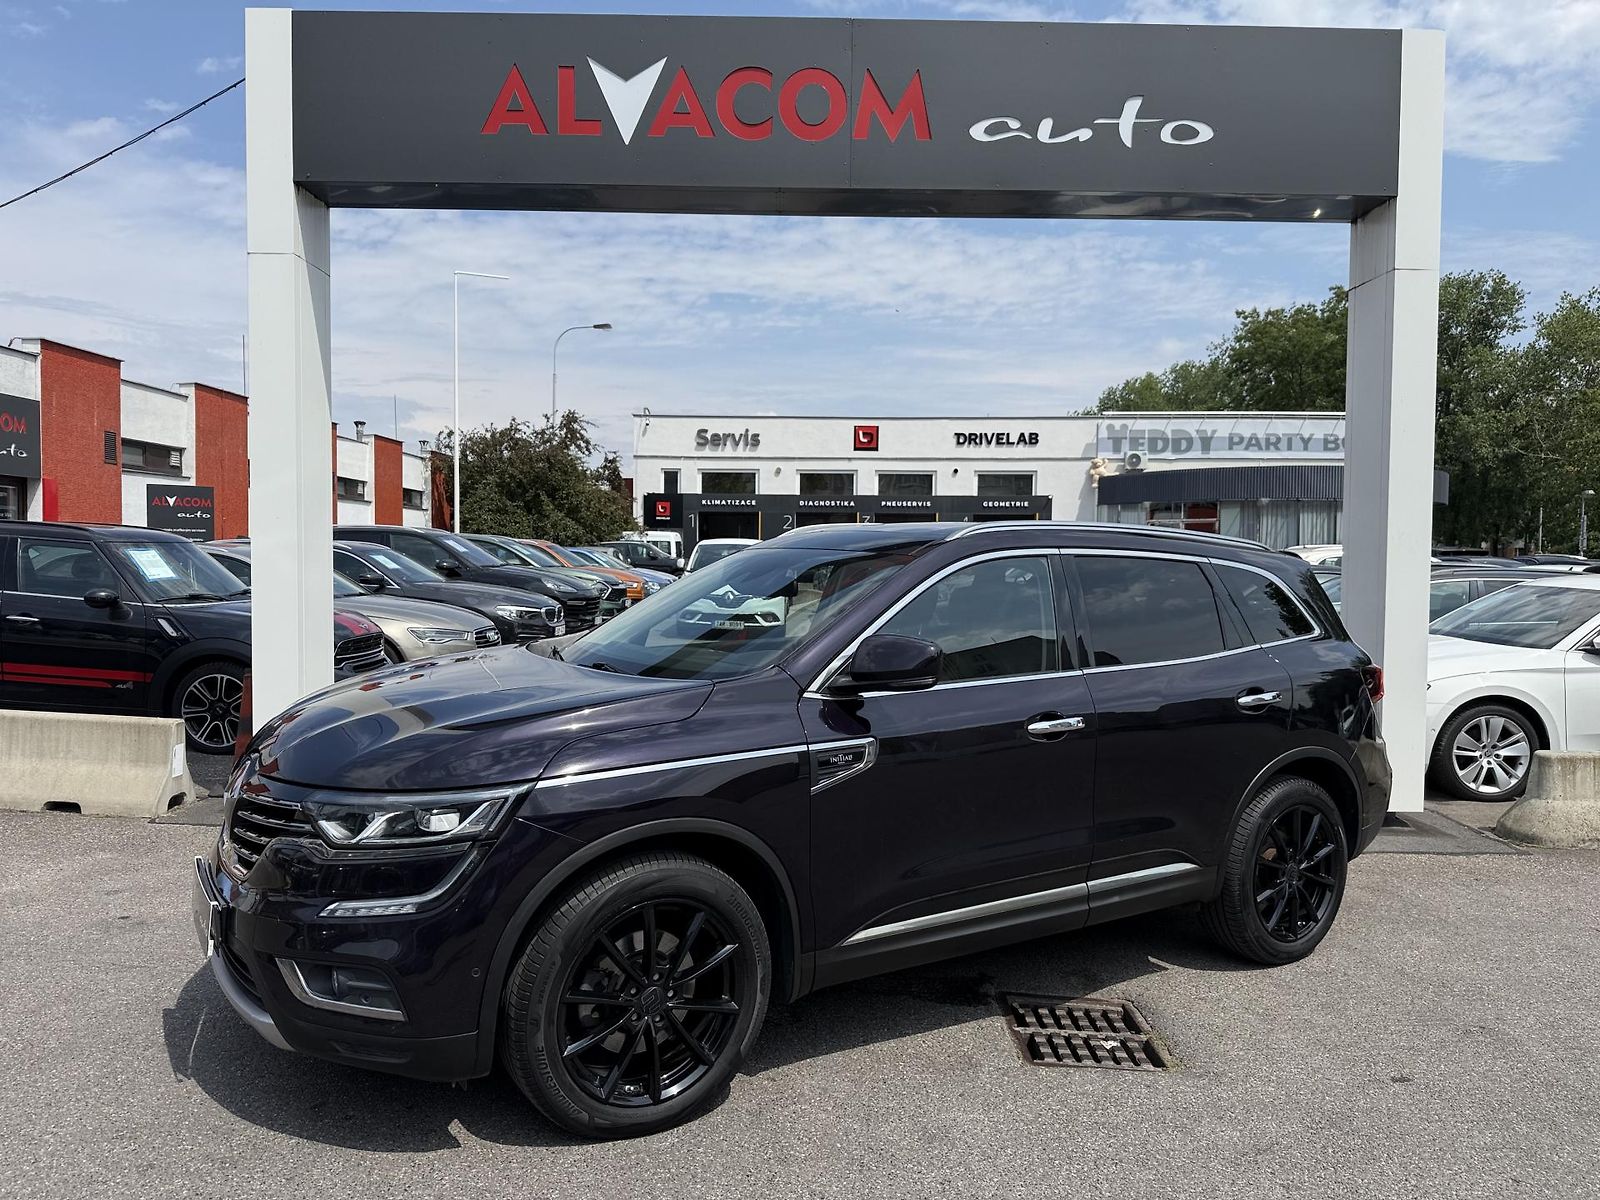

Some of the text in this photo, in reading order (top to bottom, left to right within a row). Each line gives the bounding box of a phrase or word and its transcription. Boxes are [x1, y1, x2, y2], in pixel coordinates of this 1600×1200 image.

[479, 55, 1215, 149] ALVACOM auto
[696, 428, 761, 448] Servis
[954, 432, 1040, 447] DRIVELAB
[1106, 423, 1218, 455] TEDDY
[1228, 433, 1314, 452] PARTY
[152, 495, 212, 507] ALVACOM
[881, 500, 931, 508] PNEUSERVIS
[177, 510, 211, 519] auto
[688, 513, 695, 528] 1
[783, 514, 793, 529] 2
